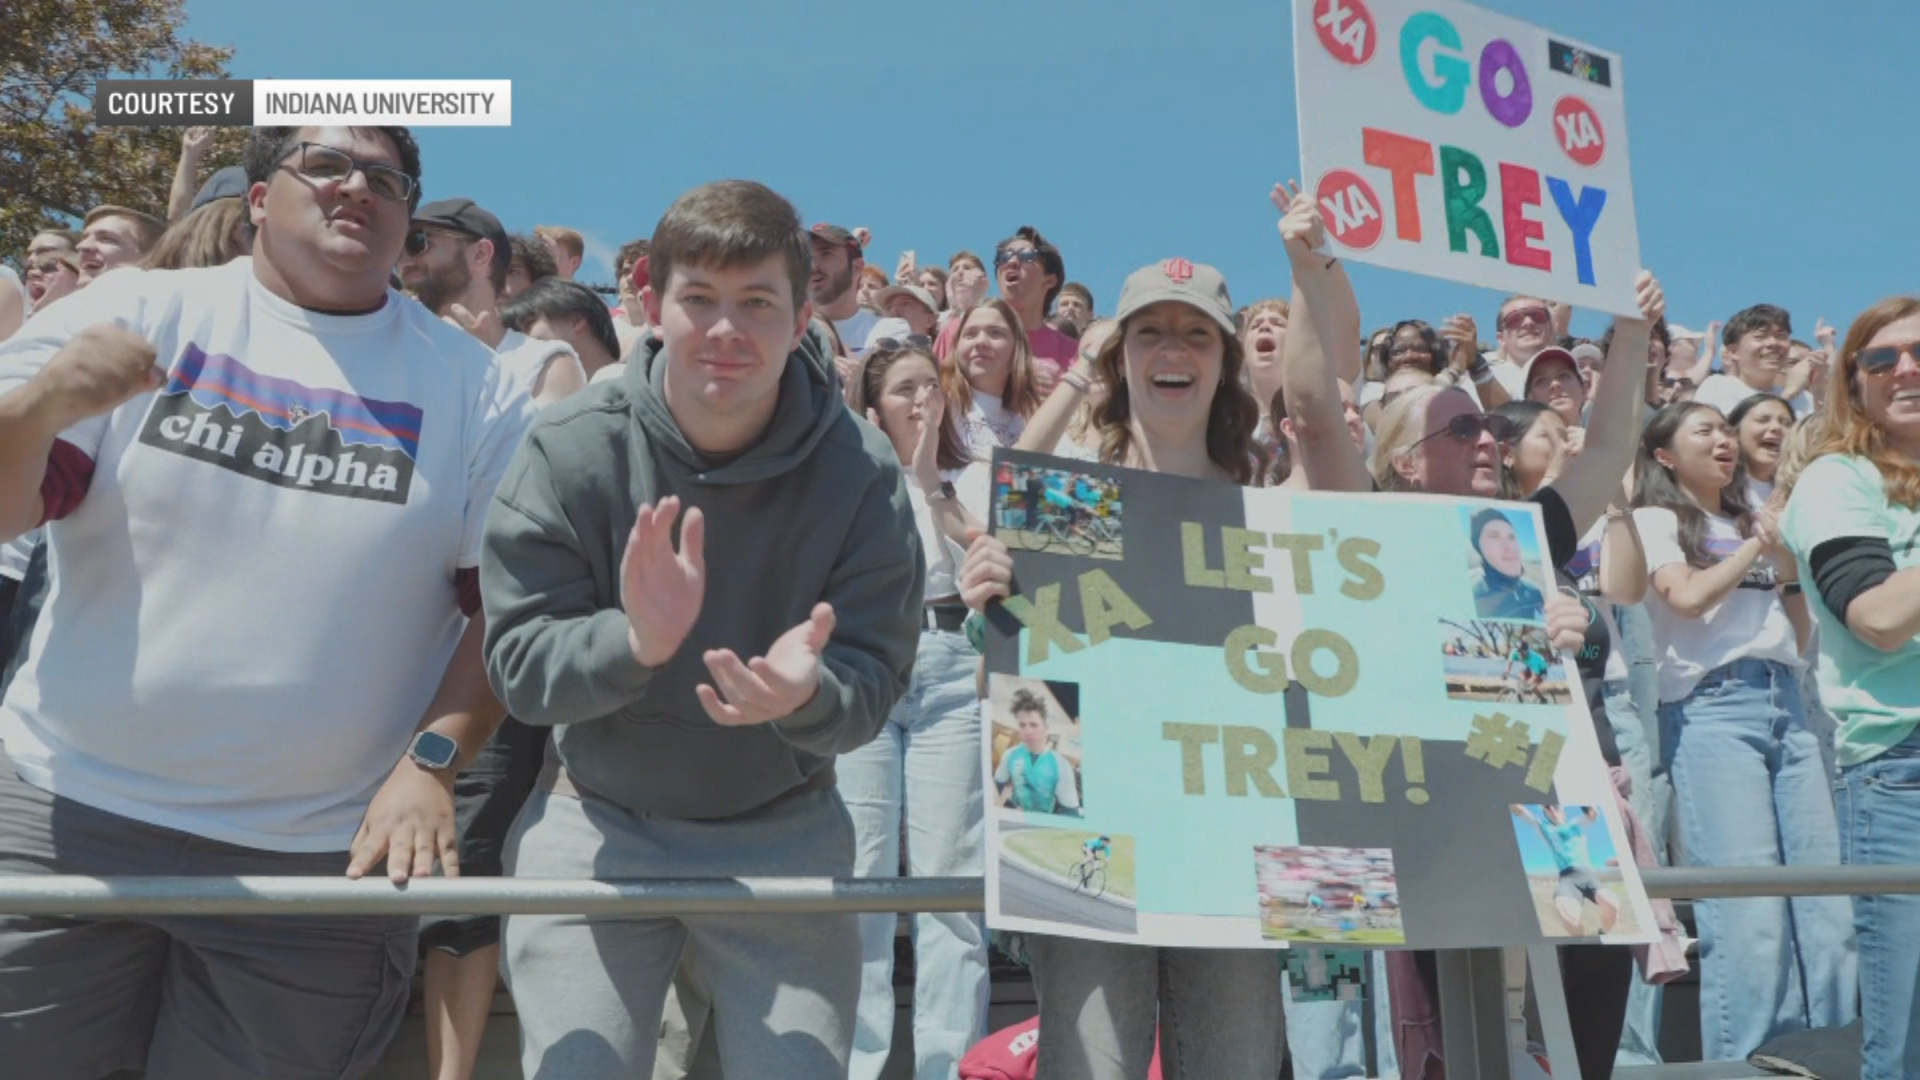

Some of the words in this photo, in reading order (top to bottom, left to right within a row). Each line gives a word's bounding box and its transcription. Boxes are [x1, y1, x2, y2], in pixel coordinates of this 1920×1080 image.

[1399, 11, 1534, 129] GO
[1555, 111, 1602, 151] XA
[1321, 184, 1379, 236] XA
[1362, 126, 1608, 288] TREY
[158, 411, 244, 459] chi
[252, 440, 398, 492] alpha
[1180, 521, 1385, 602] LET'S
[1003, 568, 1153, 666] XA
[1223, 625, 1361, 698] GO
[1162, 721, 1430, 806] TREY!
